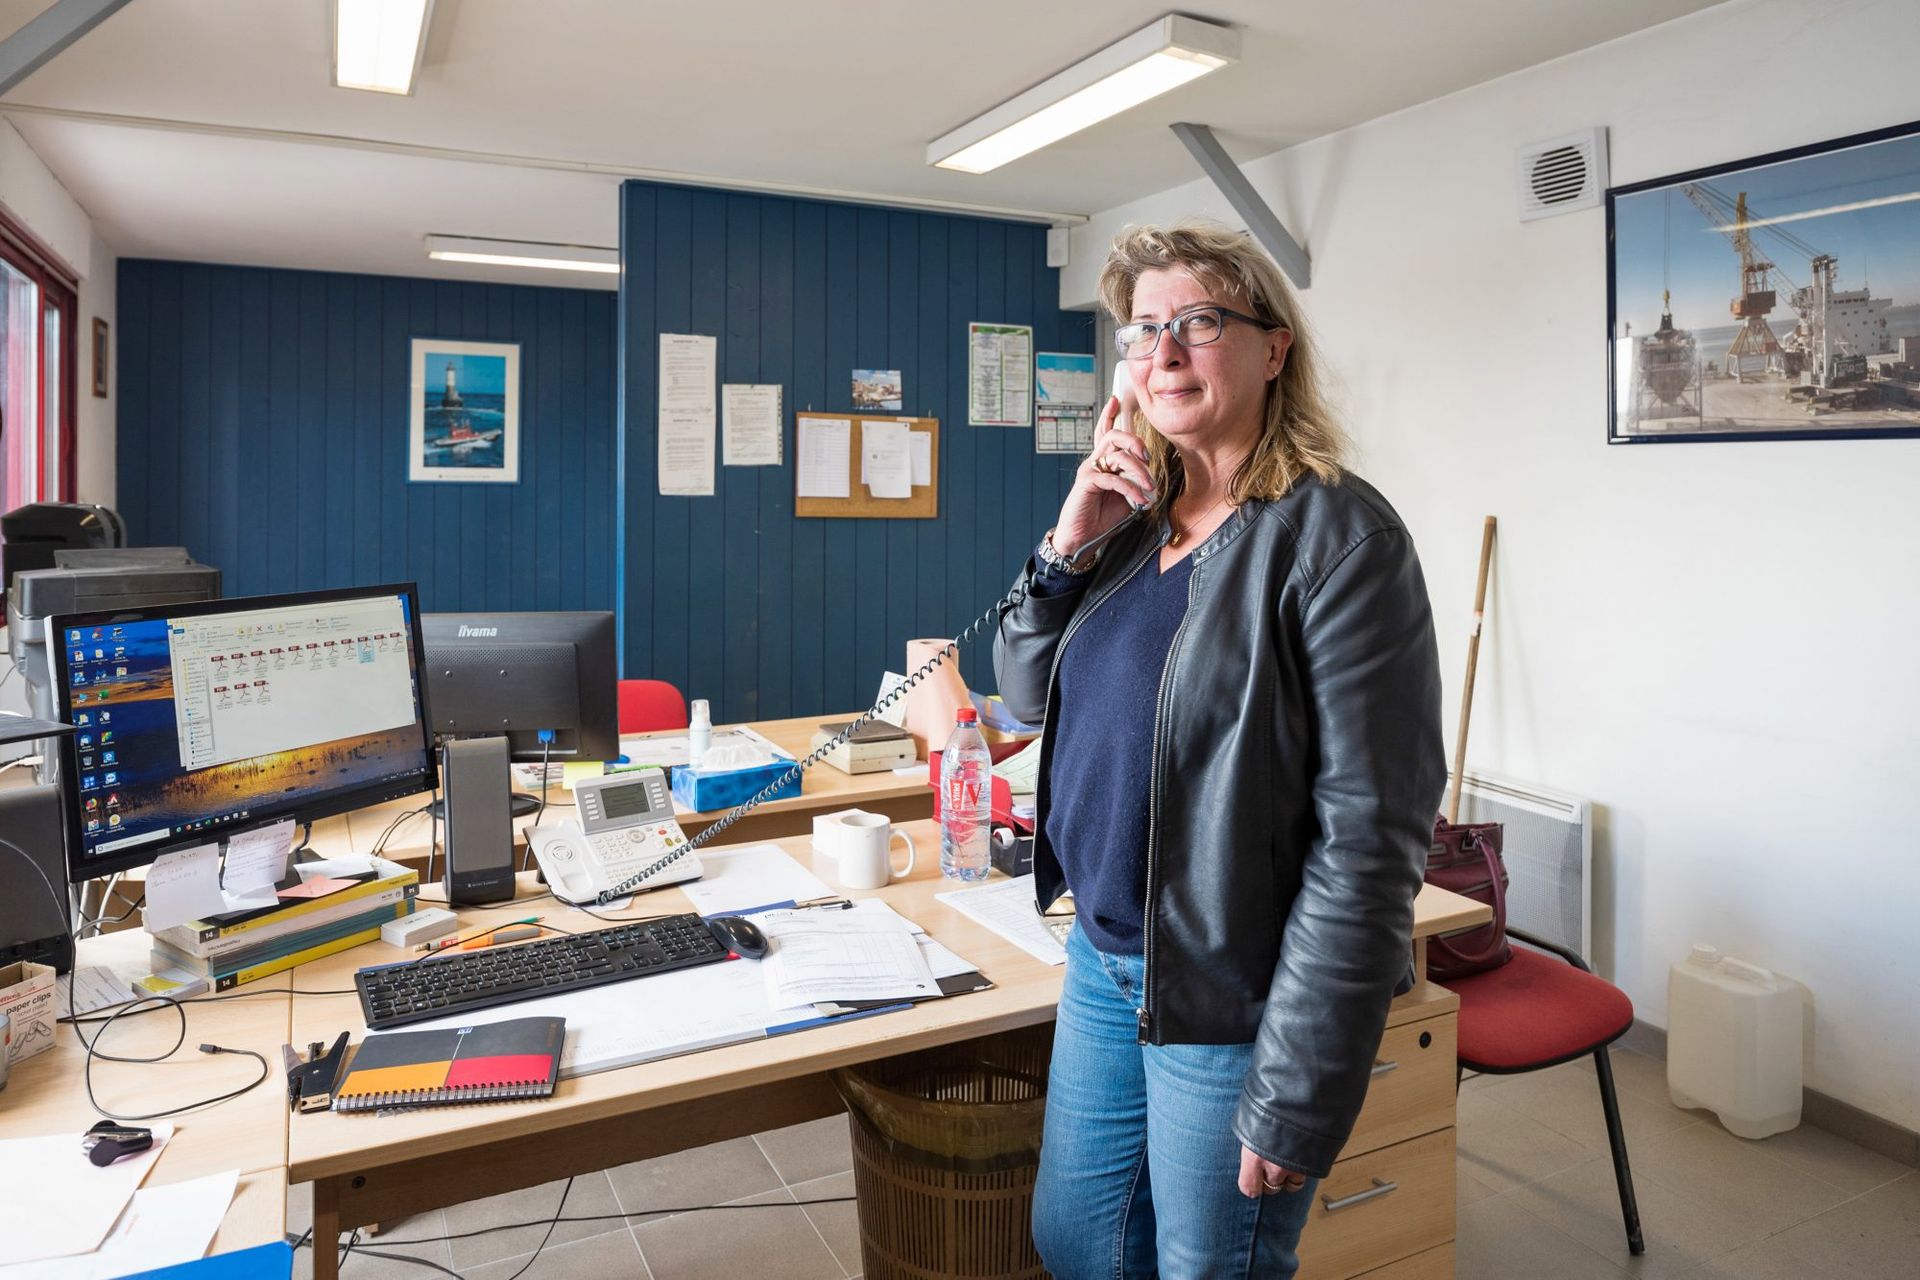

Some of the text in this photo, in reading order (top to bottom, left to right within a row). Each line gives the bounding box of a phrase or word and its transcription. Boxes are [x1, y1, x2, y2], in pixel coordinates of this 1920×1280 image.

[458, 624, 498, 637] iiyama
[205, 931, 214, 939] 14
[222, 979, 231, 987] 14
[6, 999, 31, 1015] paper
[32, 992, 52, 1005] clips
